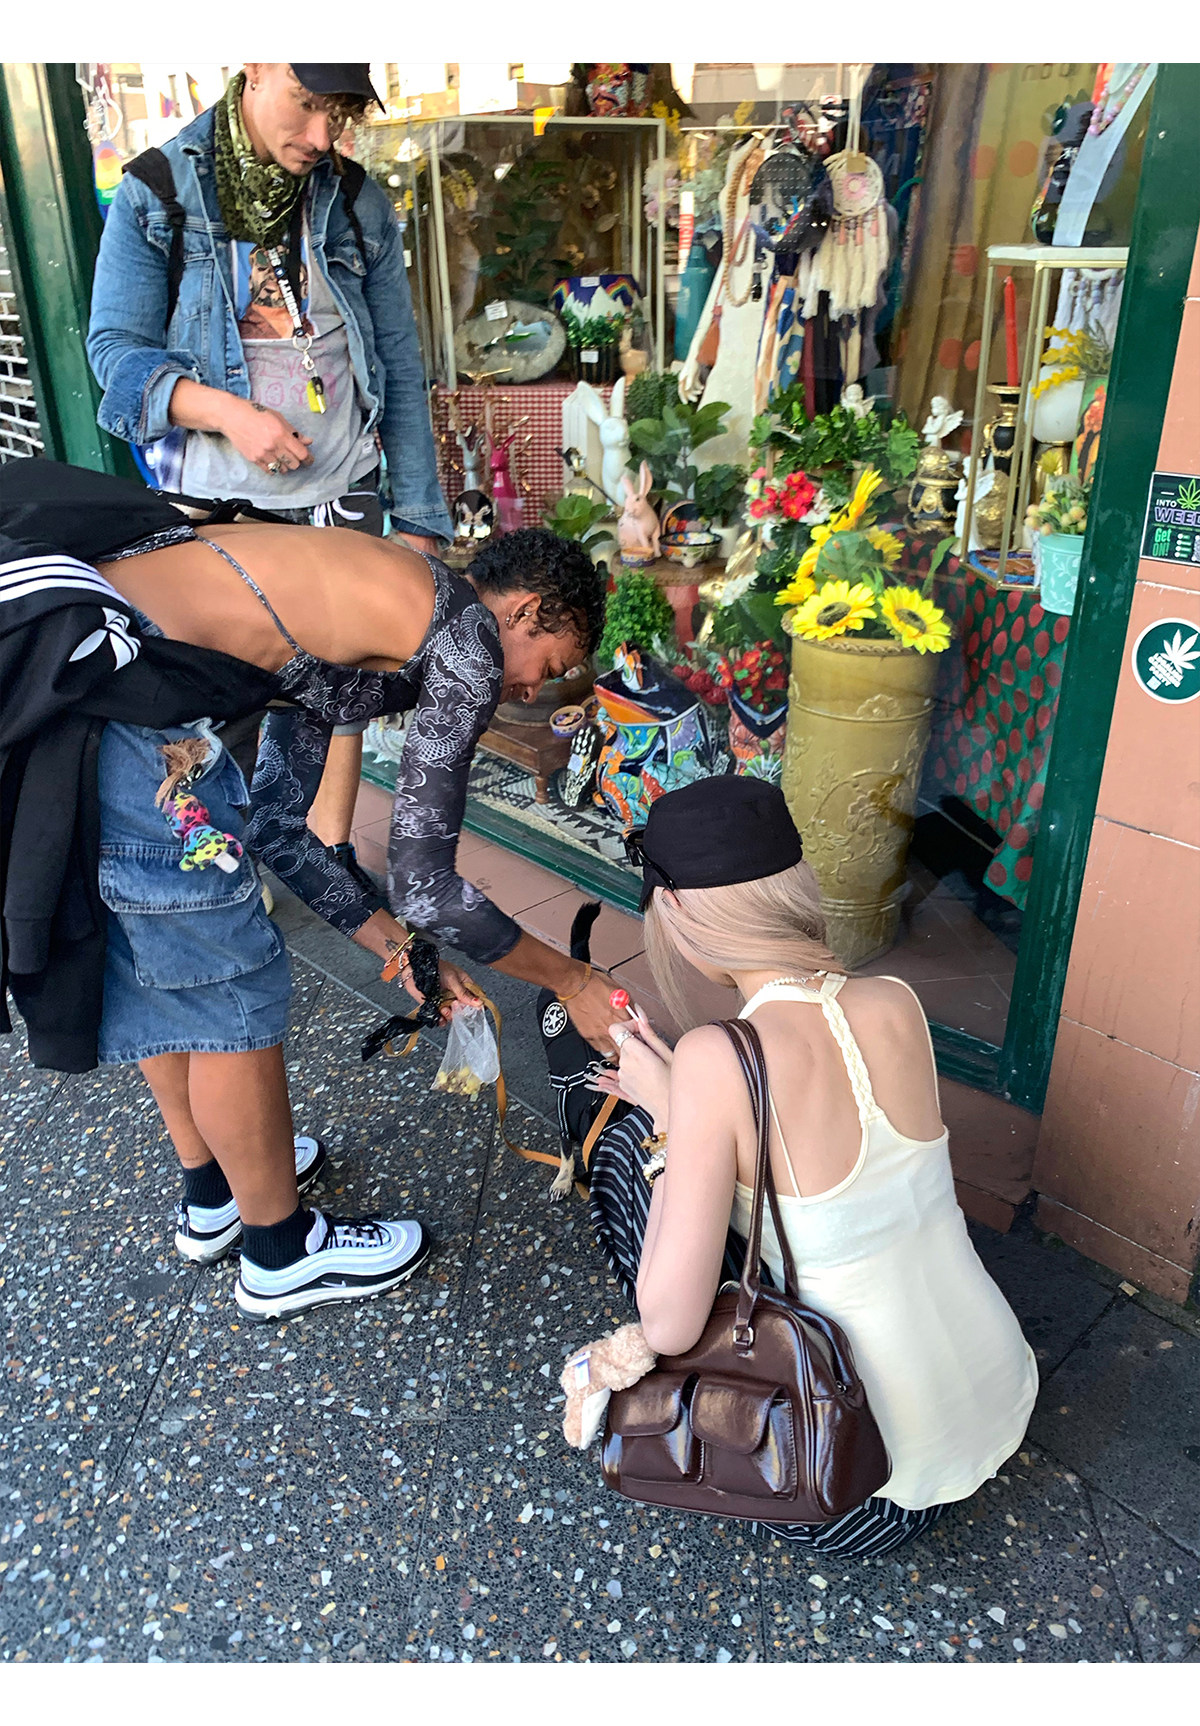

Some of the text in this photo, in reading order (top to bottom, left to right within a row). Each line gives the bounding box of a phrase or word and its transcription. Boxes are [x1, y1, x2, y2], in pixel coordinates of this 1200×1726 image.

[1156, 499, 1177, 508] INTO
[1154, 527, 1172, 543] Get
[1152, 542, 1170, 557] ON!
